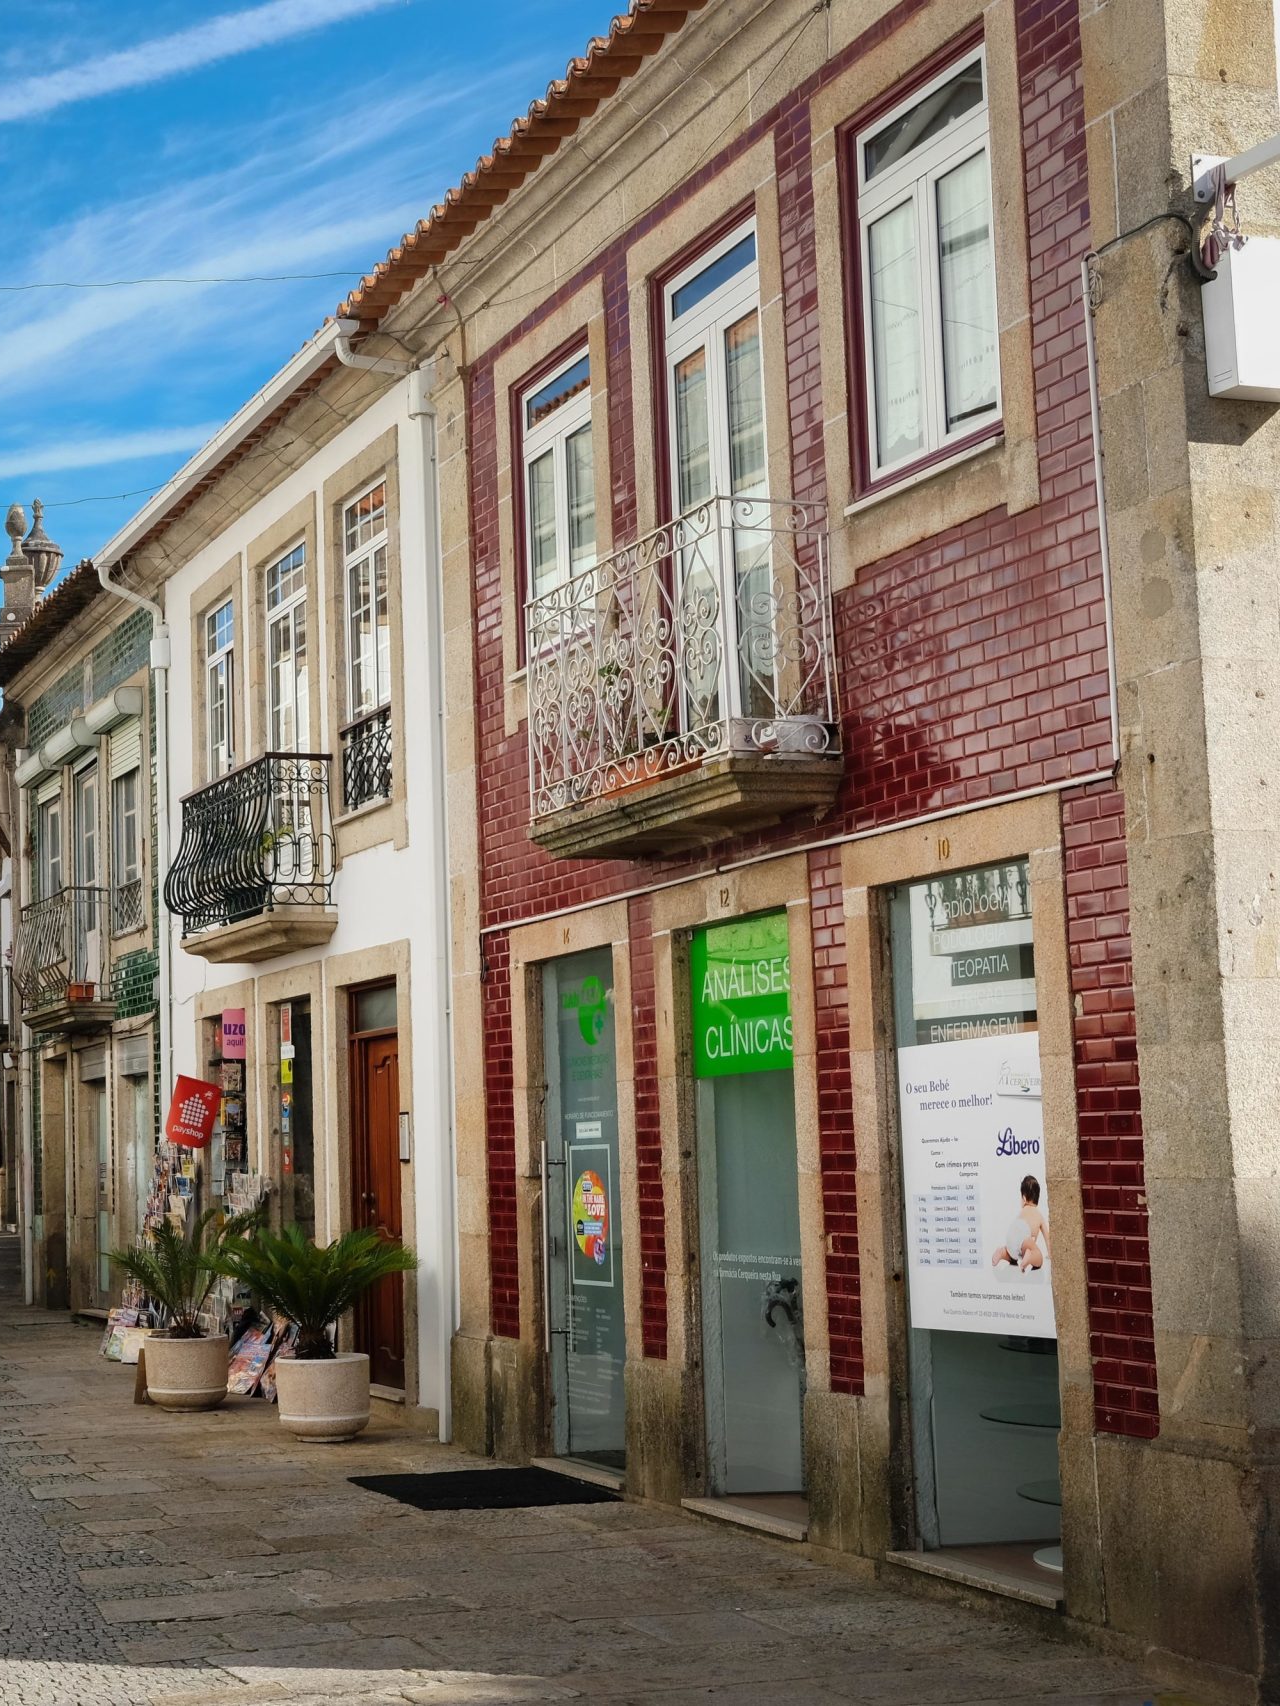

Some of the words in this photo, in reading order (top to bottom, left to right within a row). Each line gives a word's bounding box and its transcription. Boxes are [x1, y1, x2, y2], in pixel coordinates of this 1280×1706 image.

[938, 837, 950, 860] 10
[720, 887, 730, 908] 12
[943, 890, 1011, 919] RDIOLOGIA
[951, 953, 1010, 979] TEOPATIA
[702, 956, 790, 1003] ANÁLISES
[224, 1024, 246, 1036] uzo
[705, 1014, 793, 1059] CLÍNICAS
[930, 1015, 1019, 1044] ENFERMAGEM
[226, 1038, 244, 1047] aqui!
[906, 1082, 912, 1095] O
[914, 1084, 928, 1093] seu
[929, 1078, 950, 1092] Bebé
[920, 1099, 950, 1111] merece
[951, 1100, 957, 1108] o
[958, 1093, 993, 1108] melhor!
[172, 1123, 204, 1140] payshop
[996, 1126, 1041, 1157] Libero
[935, 1161, 945, 1169] Com
[587, 1204, 605, 1217] LOVE
